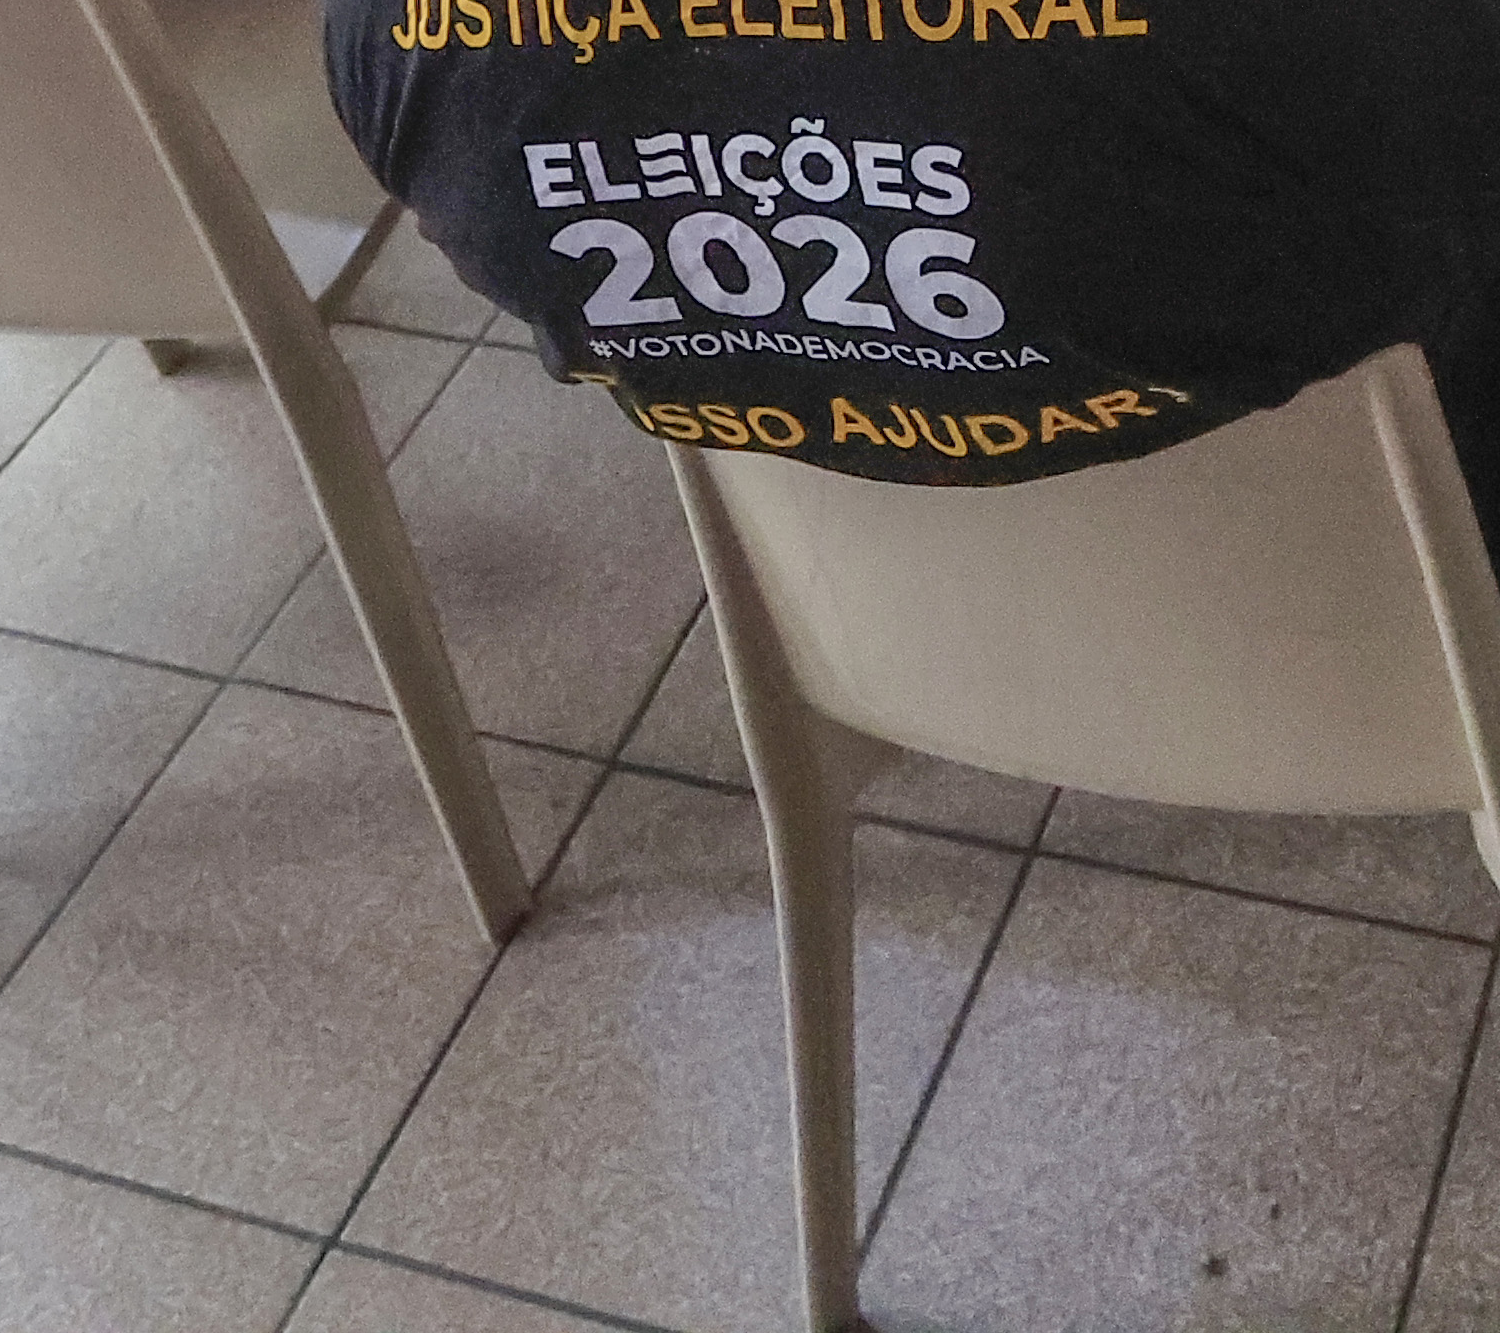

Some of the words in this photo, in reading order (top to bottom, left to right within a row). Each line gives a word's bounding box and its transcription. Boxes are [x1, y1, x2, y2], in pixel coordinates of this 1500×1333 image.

[522, 117, 972, 217] ELEIÇÕES
[549, 211, 1006, 339] 2026
[589, 328, 1050, 372] #VOTONADEMOCRACIA
